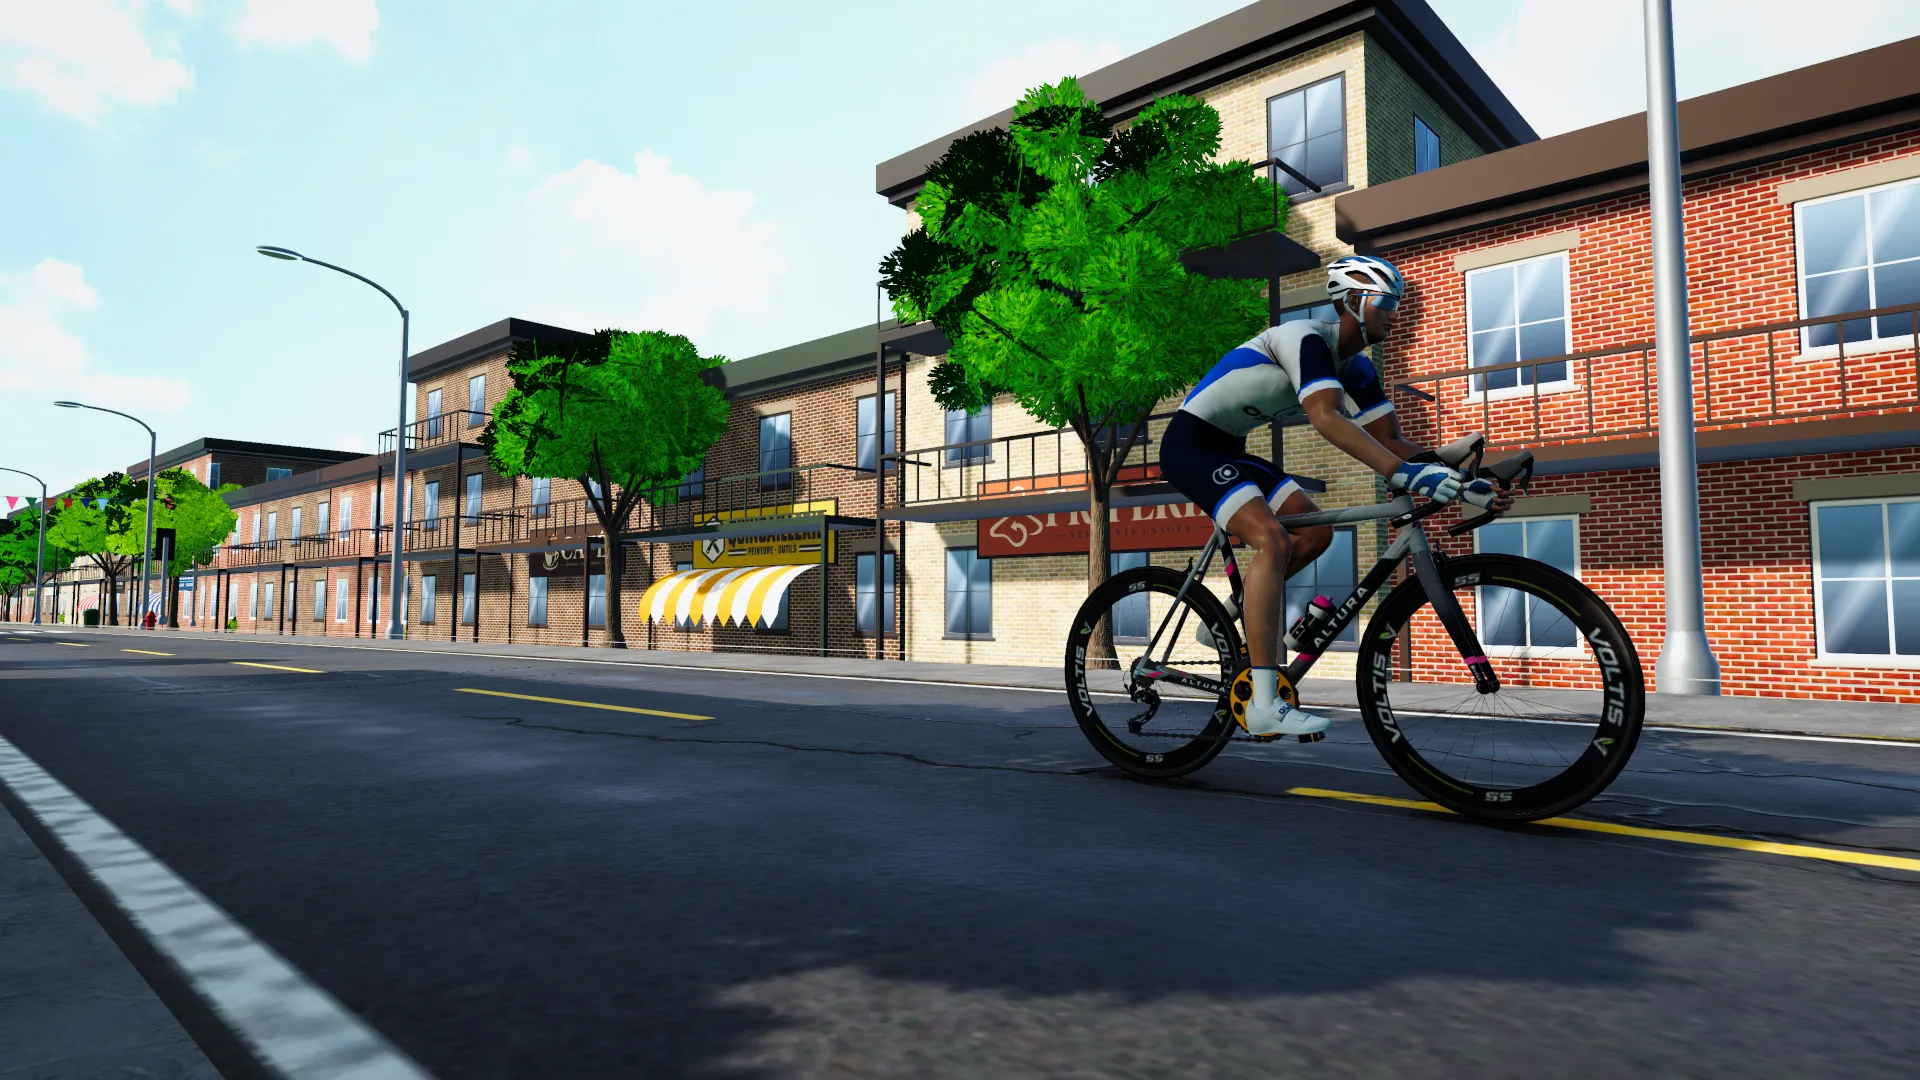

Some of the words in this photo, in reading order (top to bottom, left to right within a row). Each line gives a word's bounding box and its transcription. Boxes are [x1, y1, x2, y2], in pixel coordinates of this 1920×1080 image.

[748, 546, 774, 556] PEINTURE
[778, 544, 797, 554] OUTILS
[1313, 587, 1369, 648] ALTURA
[1075, 645, 1093, 716] VOLTIS
[1181, 678, 1226, 693] ALTURA
[1372, 652, 1401, 744] VOLTIS
[1588, 627, 1625, 727] VOLTIS
